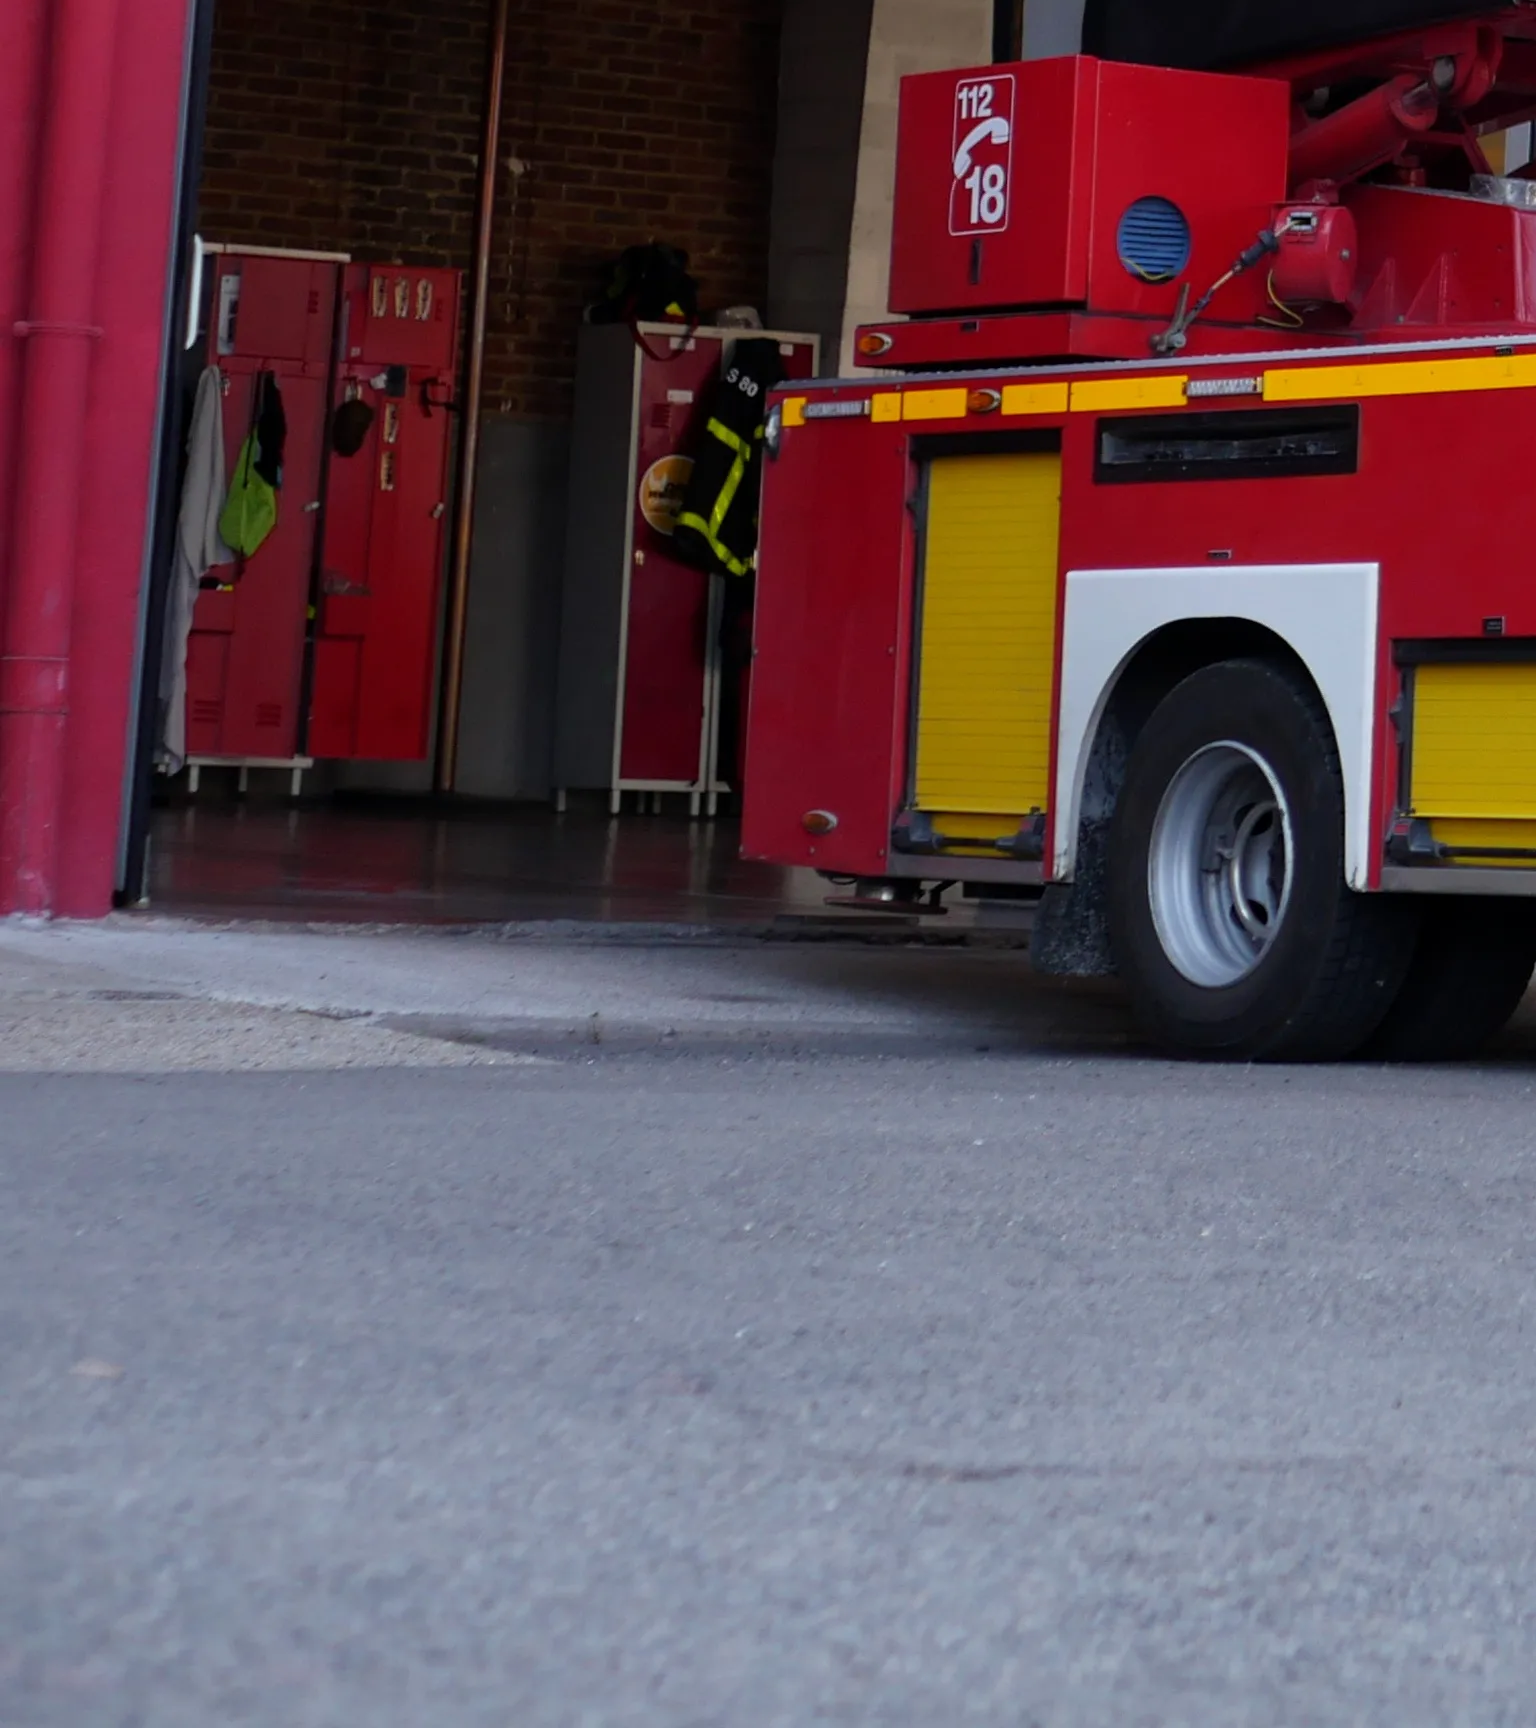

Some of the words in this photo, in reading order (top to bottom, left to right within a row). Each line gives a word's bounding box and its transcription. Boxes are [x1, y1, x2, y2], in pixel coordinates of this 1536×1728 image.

[958, 83, 993, 119] 112
[965, 164, 1005, 224] 18
[726, 367, 740, 383] S
[738, 375, 759, 397] 80
